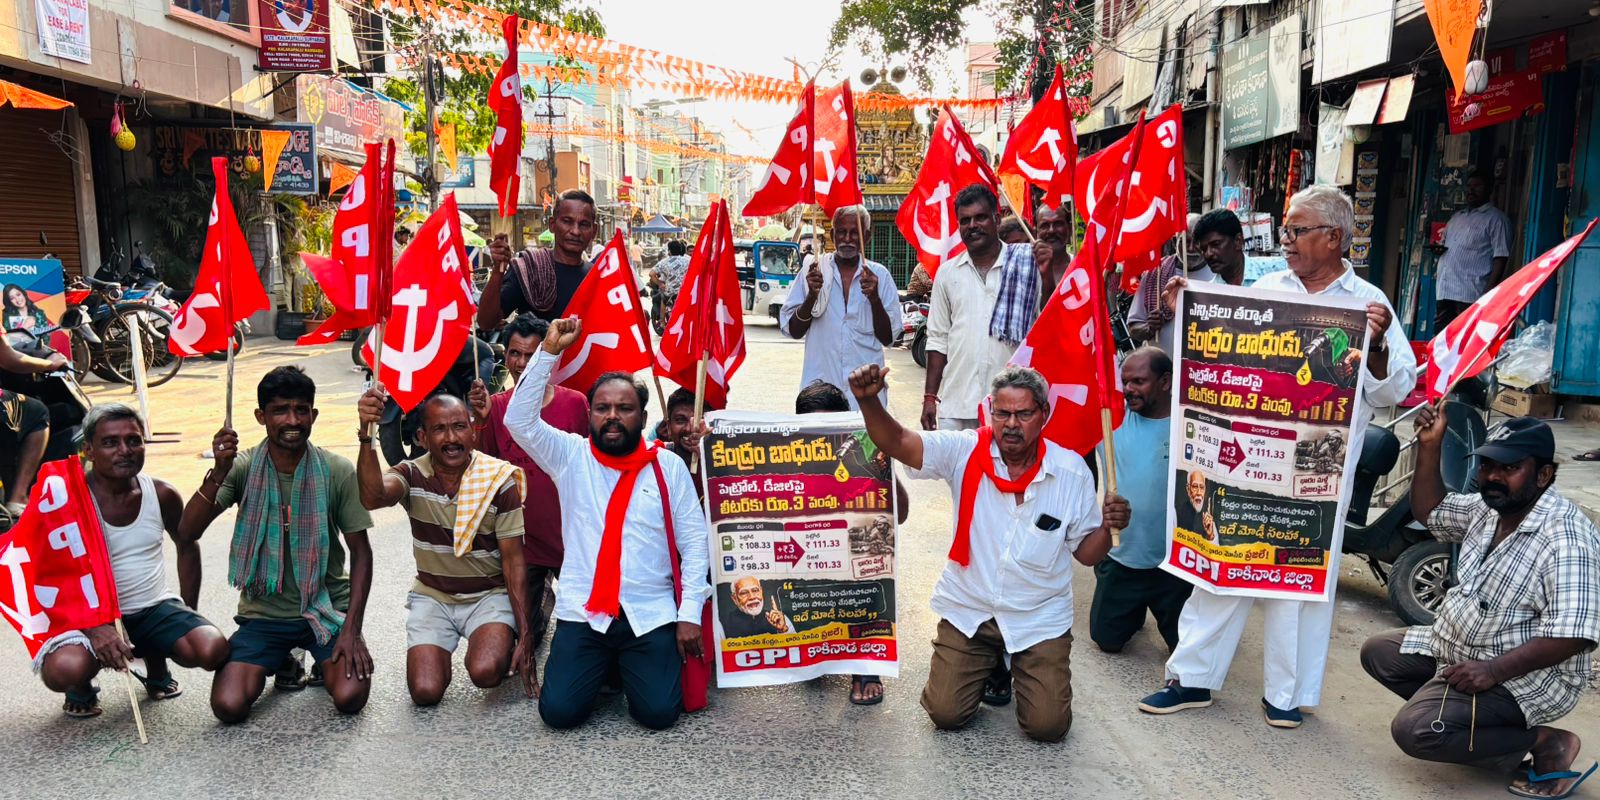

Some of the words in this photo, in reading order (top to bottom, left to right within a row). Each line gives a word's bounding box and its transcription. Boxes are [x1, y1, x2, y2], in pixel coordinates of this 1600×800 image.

[156, 126, 176, 149] SRI
[0, 264, 38, 275] EPSON
[1189, 303, 1232, 320] ఎన్నికలు
[1234, 308, 1274, 325] తర్వాత
[1187, 322, 1232, 359] కేంద్రం
[1188, 368, 1219, 385] పెట్రోల్,
[1220, 390, 1258, 410] రూ.3
[1261, 396, 1294, 416] పెంపు.
[1202, 435, 1220, 446] 108.33
[712, 440, 766, 470] కేంద్రం
[1256, 448, 1285, 459] 111.33
[1200, 457, 1214, 468] 98.33
[1253, 471, 1282, 482] 101.33
[718, 480, 762, 495] పెట్రోల్,
[766, 496, 804, 512] రూ.3
[808, 496, 841, 510] పెంపు.
[1220, 498, 1240, 510] కేంద్రం
[1219, 522, 1238, 535] ఇదే
[1266, 527, 1299, 540] సలహా
[746, 542, 770, 550] 108.33
[812, 540, 840, 548] 111.33
[746, 562, 770, 570] 98.33
[814, 560, 842, 570] 101.33
[1178, 546, 1221, 582] CPI
[1227, 565, 1282, 583] కాకినాడ
[1284, 571, 1314, 590] జిల్లా
[790, 592, 808, 600] కేంద్రం
[810, 590, 828, 598] ధరలు
[792, 610, 809, 622] ఇదే
[838, 608, 868, 618] సలహా
[735, 646, 800, 668] CPI
[808, 642, 858, 658] కాకినాడ
[860, 642, 887, 658] జిల్లా
